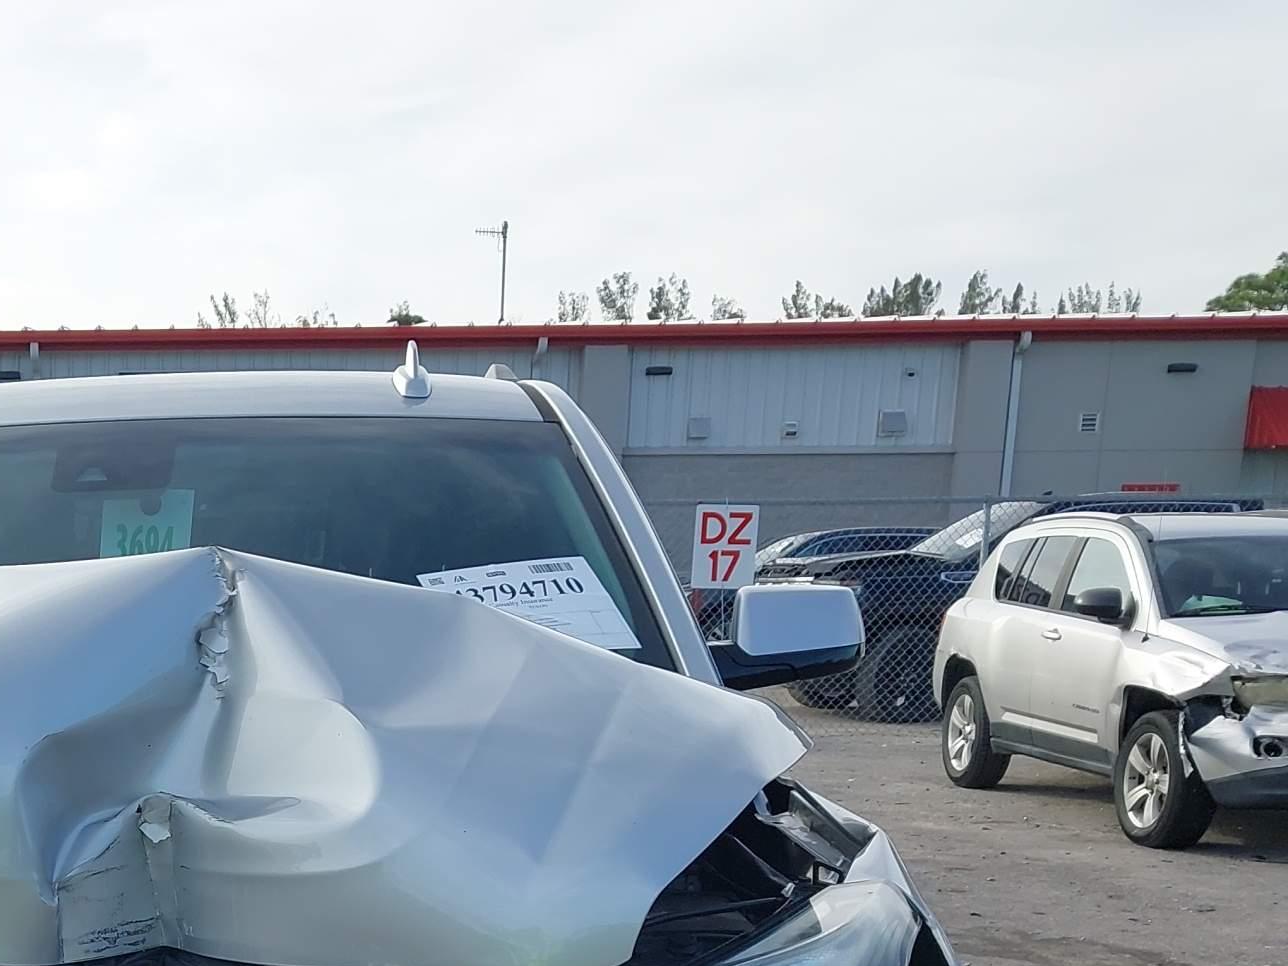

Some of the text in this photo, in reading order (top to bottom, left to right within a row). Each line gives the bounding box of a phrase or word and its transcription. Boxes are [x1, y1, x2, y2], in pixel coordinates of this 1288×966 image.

[700, 511, 754, 545] DZ
[708, 550, 741, 582] 17
[455, 576, 585, 604] 3794710
